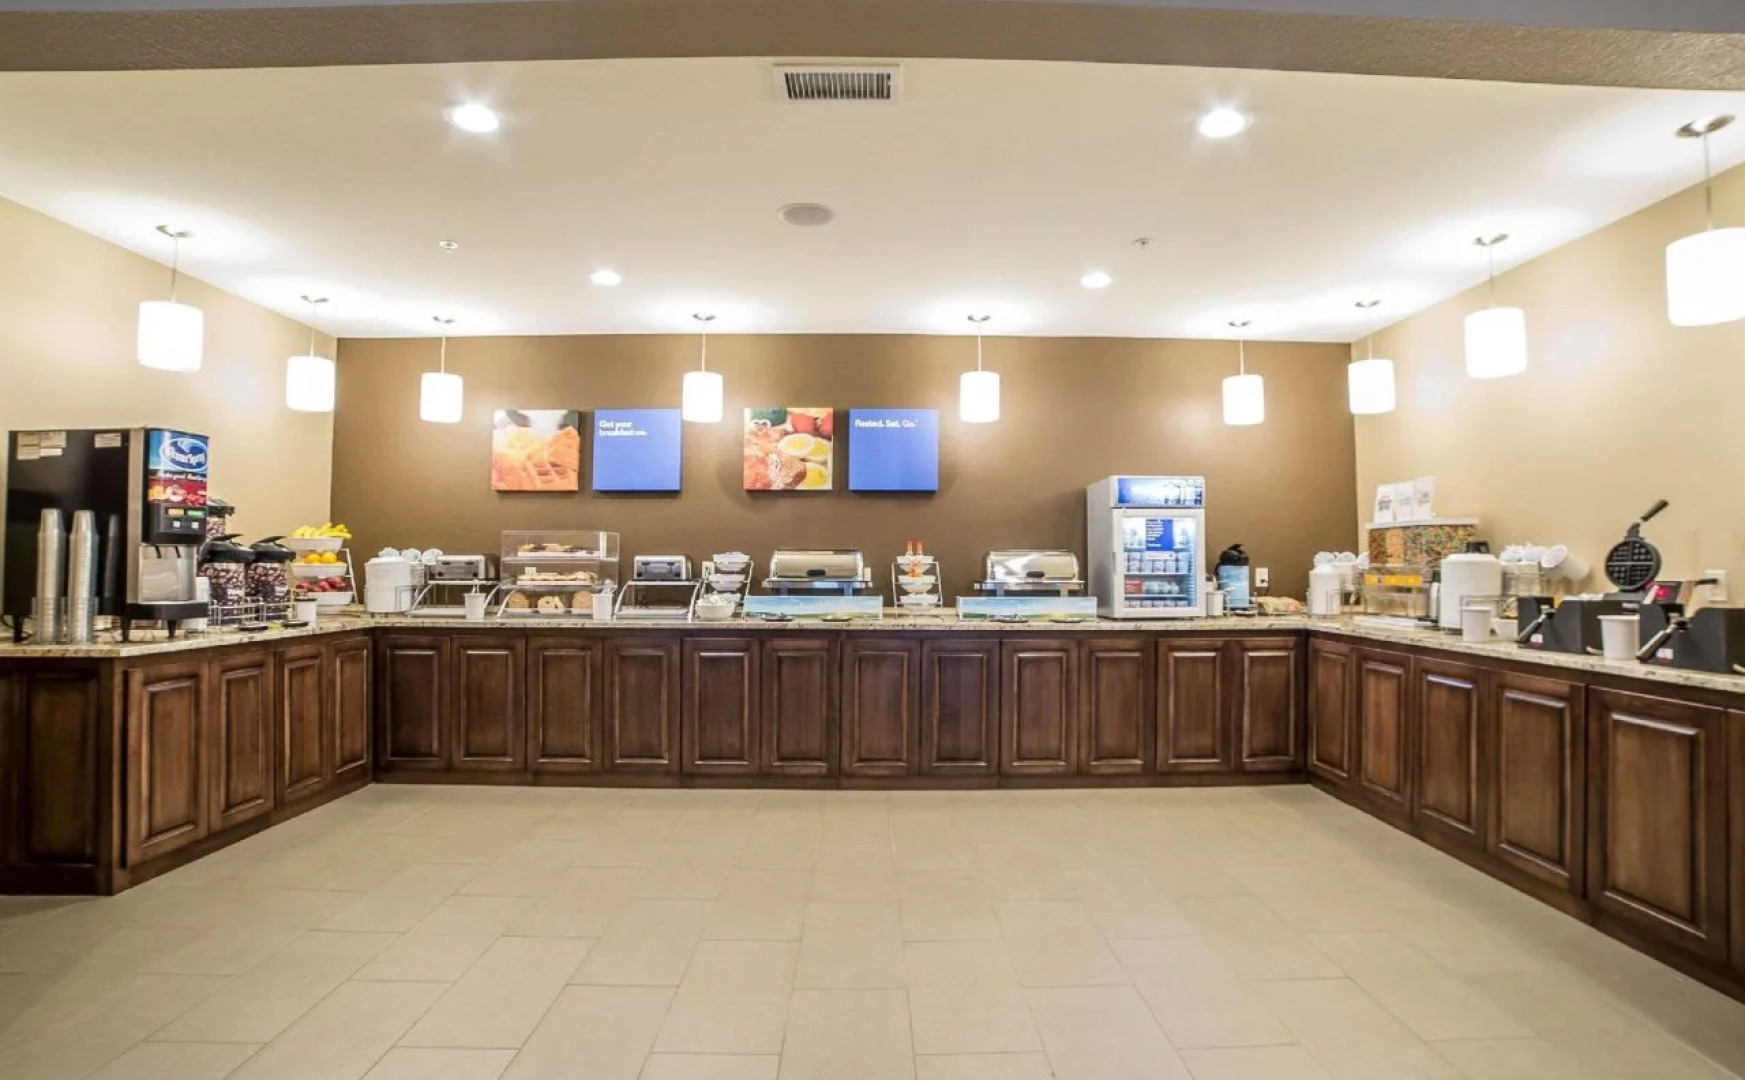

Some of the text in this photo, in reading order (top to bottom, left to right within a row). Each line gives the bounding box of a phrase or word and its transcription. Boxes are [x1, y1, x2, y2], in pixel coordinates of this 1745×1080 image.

[599, 419, 632, 431] Get your
[599, 428, 634, 437] breakfast
